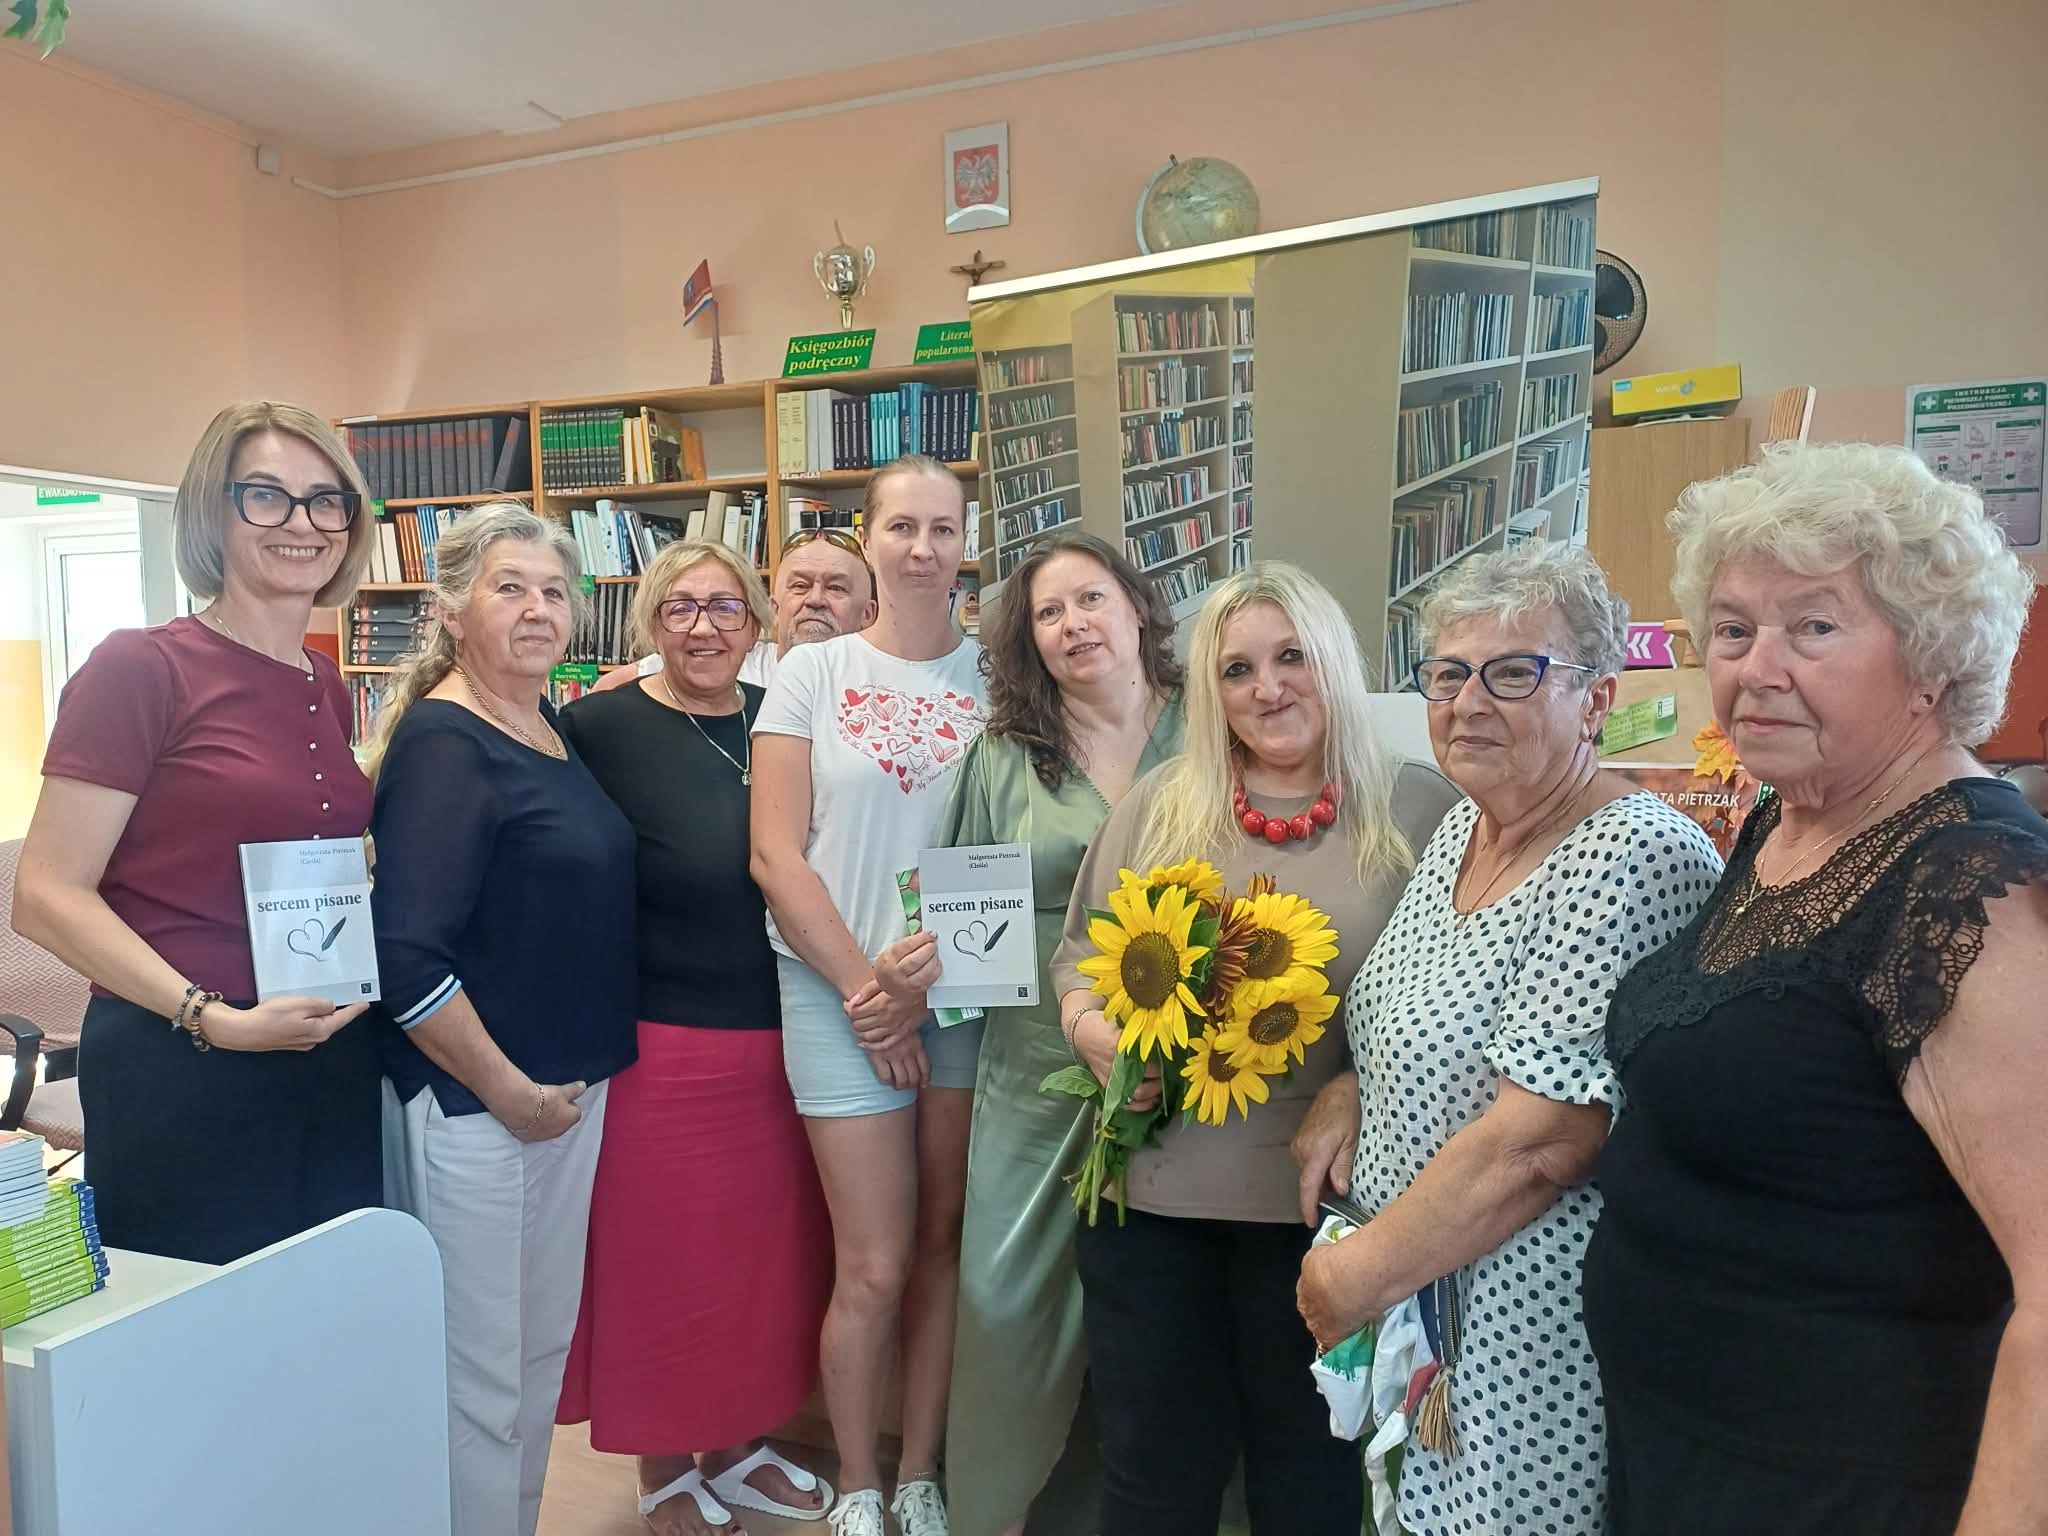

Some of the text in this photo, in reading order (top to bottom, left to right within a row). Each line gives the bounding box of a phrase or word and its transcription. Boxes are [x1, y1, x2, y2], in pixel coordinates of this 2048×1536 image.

[789, 334, 873, 355] Księgozbiór
[788, 354, 862, 374] podręczny
[1677, 792, 1741, 808] PIETRZAK
[257, 893, 362, 913] sercem pisane
[928, 897, 1024, 914] sercem pisane
